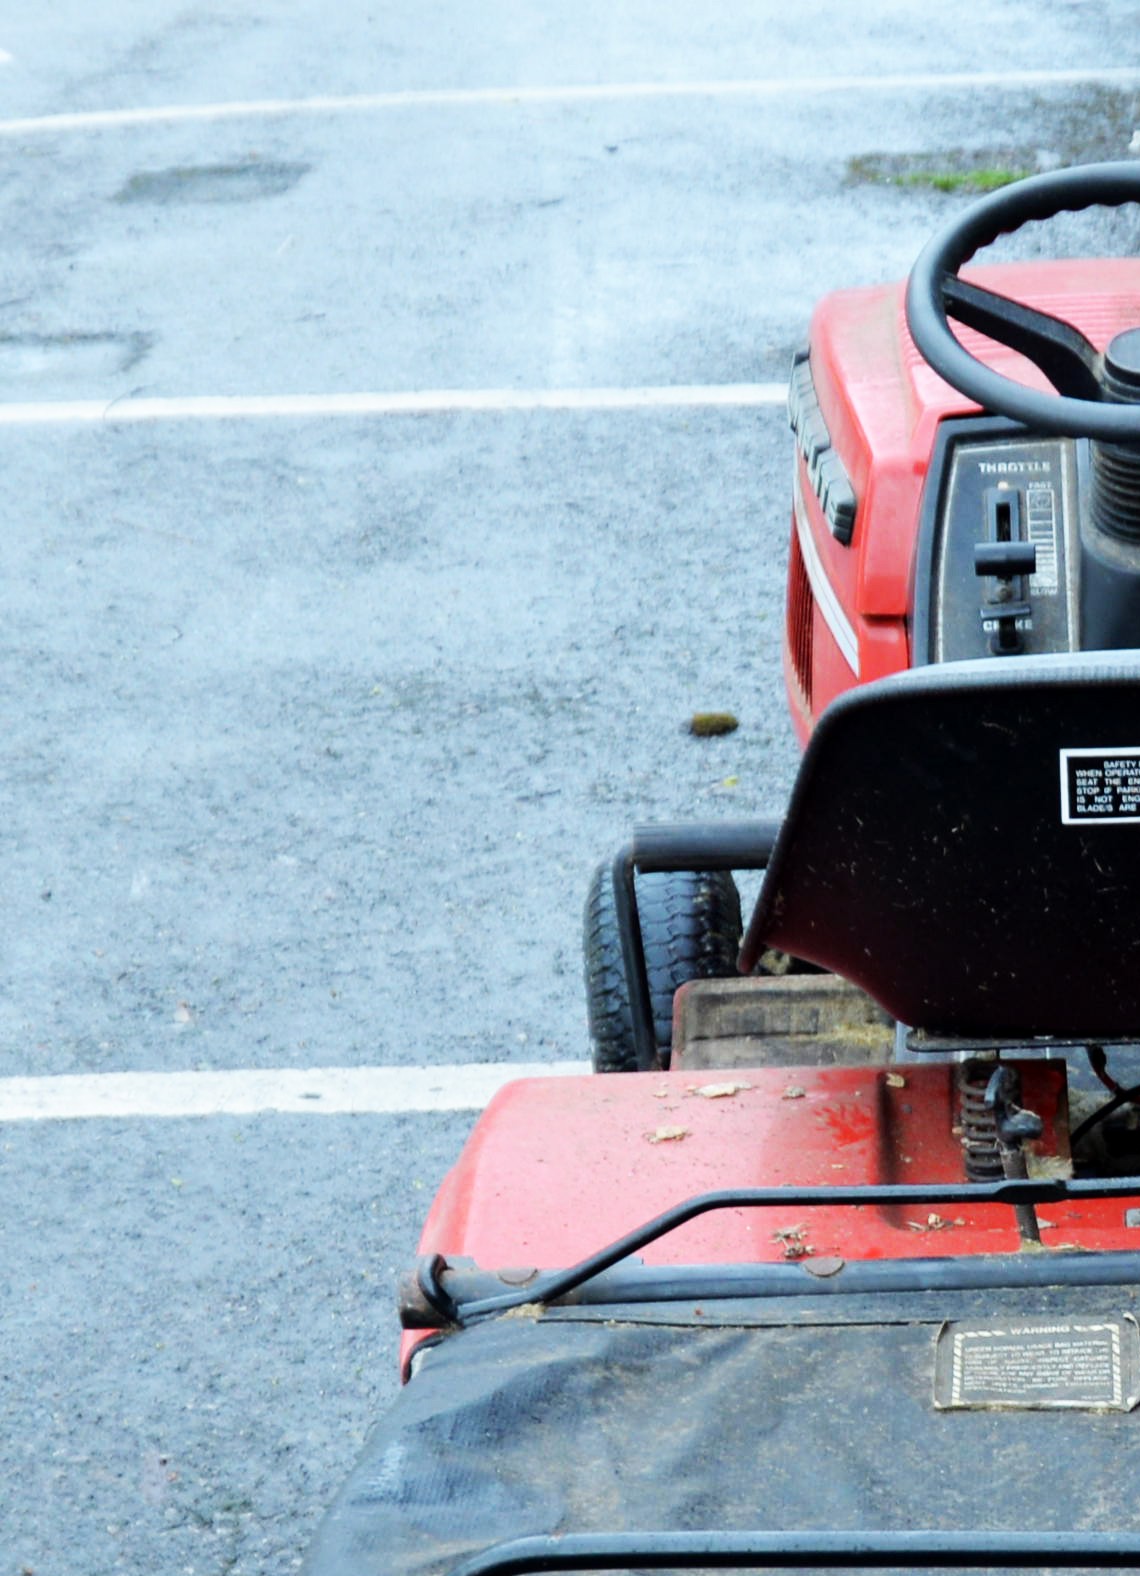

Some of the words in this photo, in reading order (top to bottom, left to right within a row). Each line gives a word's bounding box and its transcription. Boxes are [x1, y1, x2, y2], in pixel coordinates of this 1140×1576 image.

[978, 462, 1050, 473] THROTTLE
[982, 619, 1032, 632] CHKE
[1104, 760, 1136, 768] SAFETY
[1076, 770, 1102, 778] WHEN
[1076, 778, 1098, 786] SEAT
[1104, 778, 1122, 786] THE
[1076, 786, 1100, 794] STOP
[1104, 786, 1112, 794] IF
[1076, 796, 1086, 804] IS
[1094, 795, 1113, 803] NOT
[1118, 804, 1137, 812] ARE
[1010, 1324, 1070, 1336] WARNING
